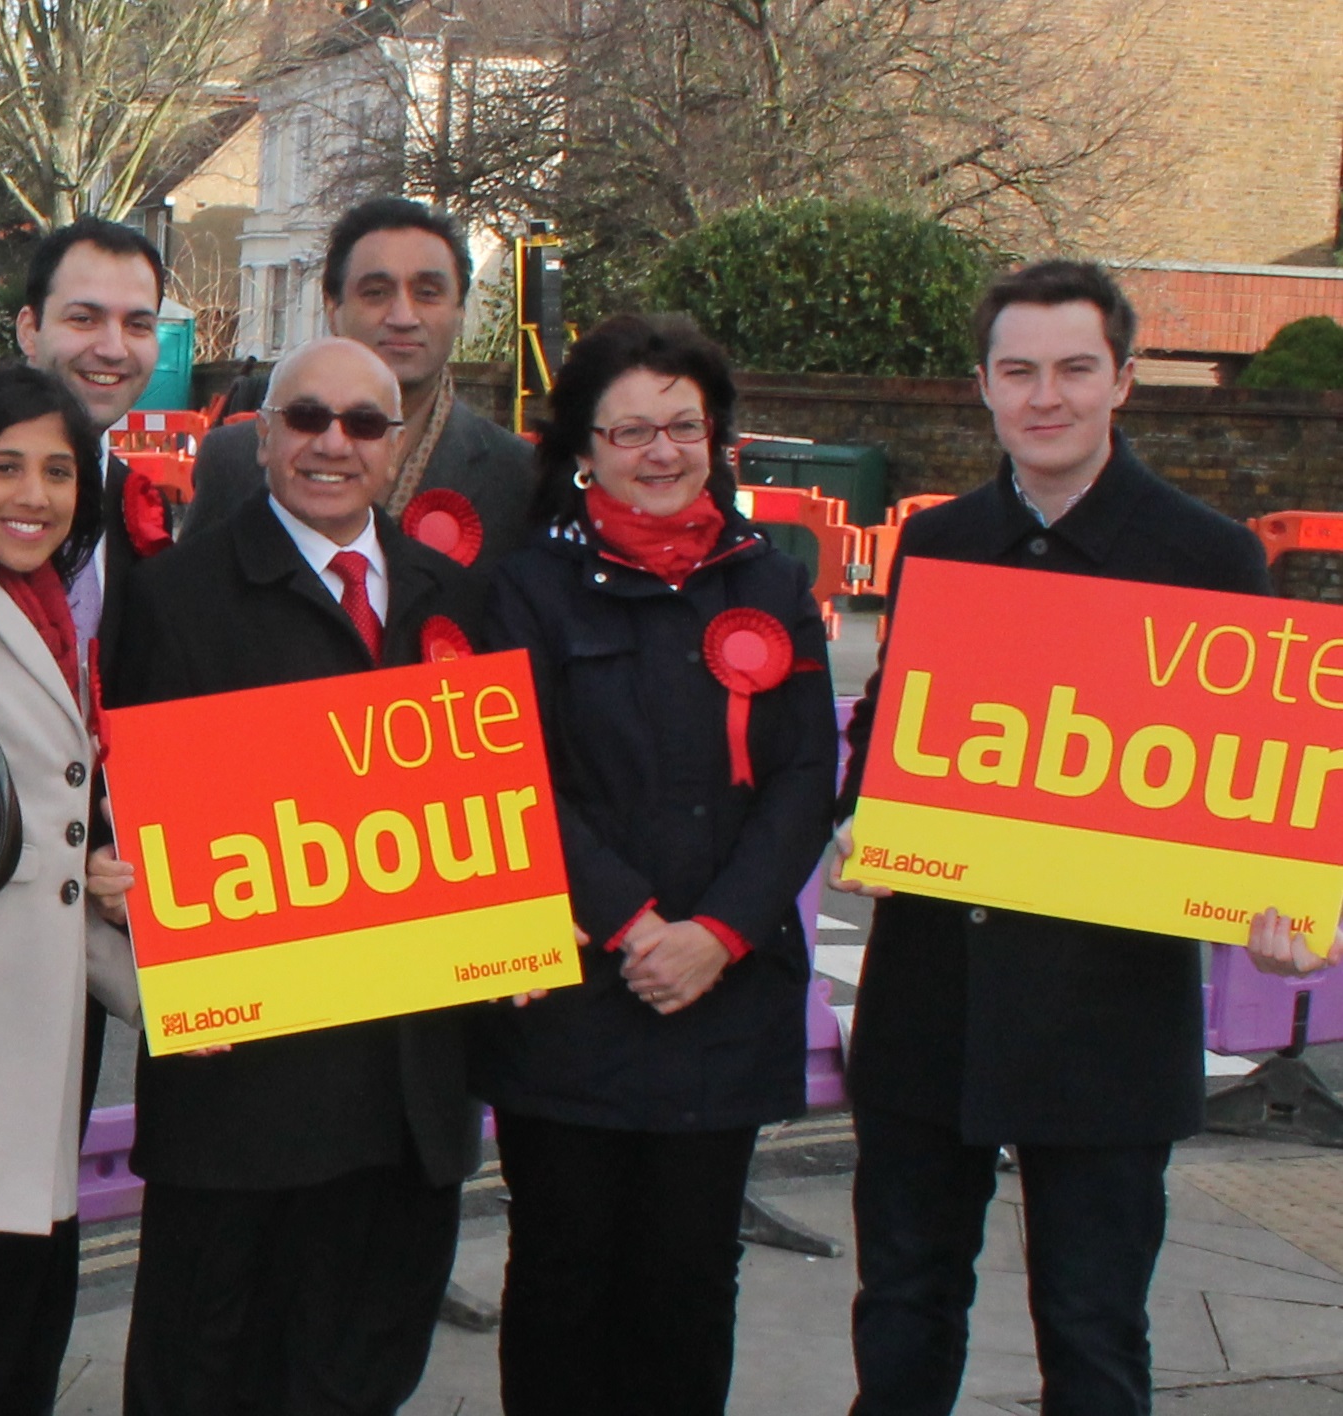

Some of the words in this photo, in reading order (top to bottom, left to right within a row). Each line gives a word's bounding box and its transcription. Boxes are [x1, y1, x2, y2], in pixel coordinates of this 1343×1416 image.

[1144, 616, 1343, 709] vote
[328, 679, 524, 777] vote
[892, 670, 1343, 829] Labour
[138, 785, 537, 931] Labour
[881, 849, 968, 881] Labour
[1184, 898, 1315, 934] labour.uk
[454, 948, 563, 982] labour.org.uk
[182, 1002, 262, 1033] Labour
